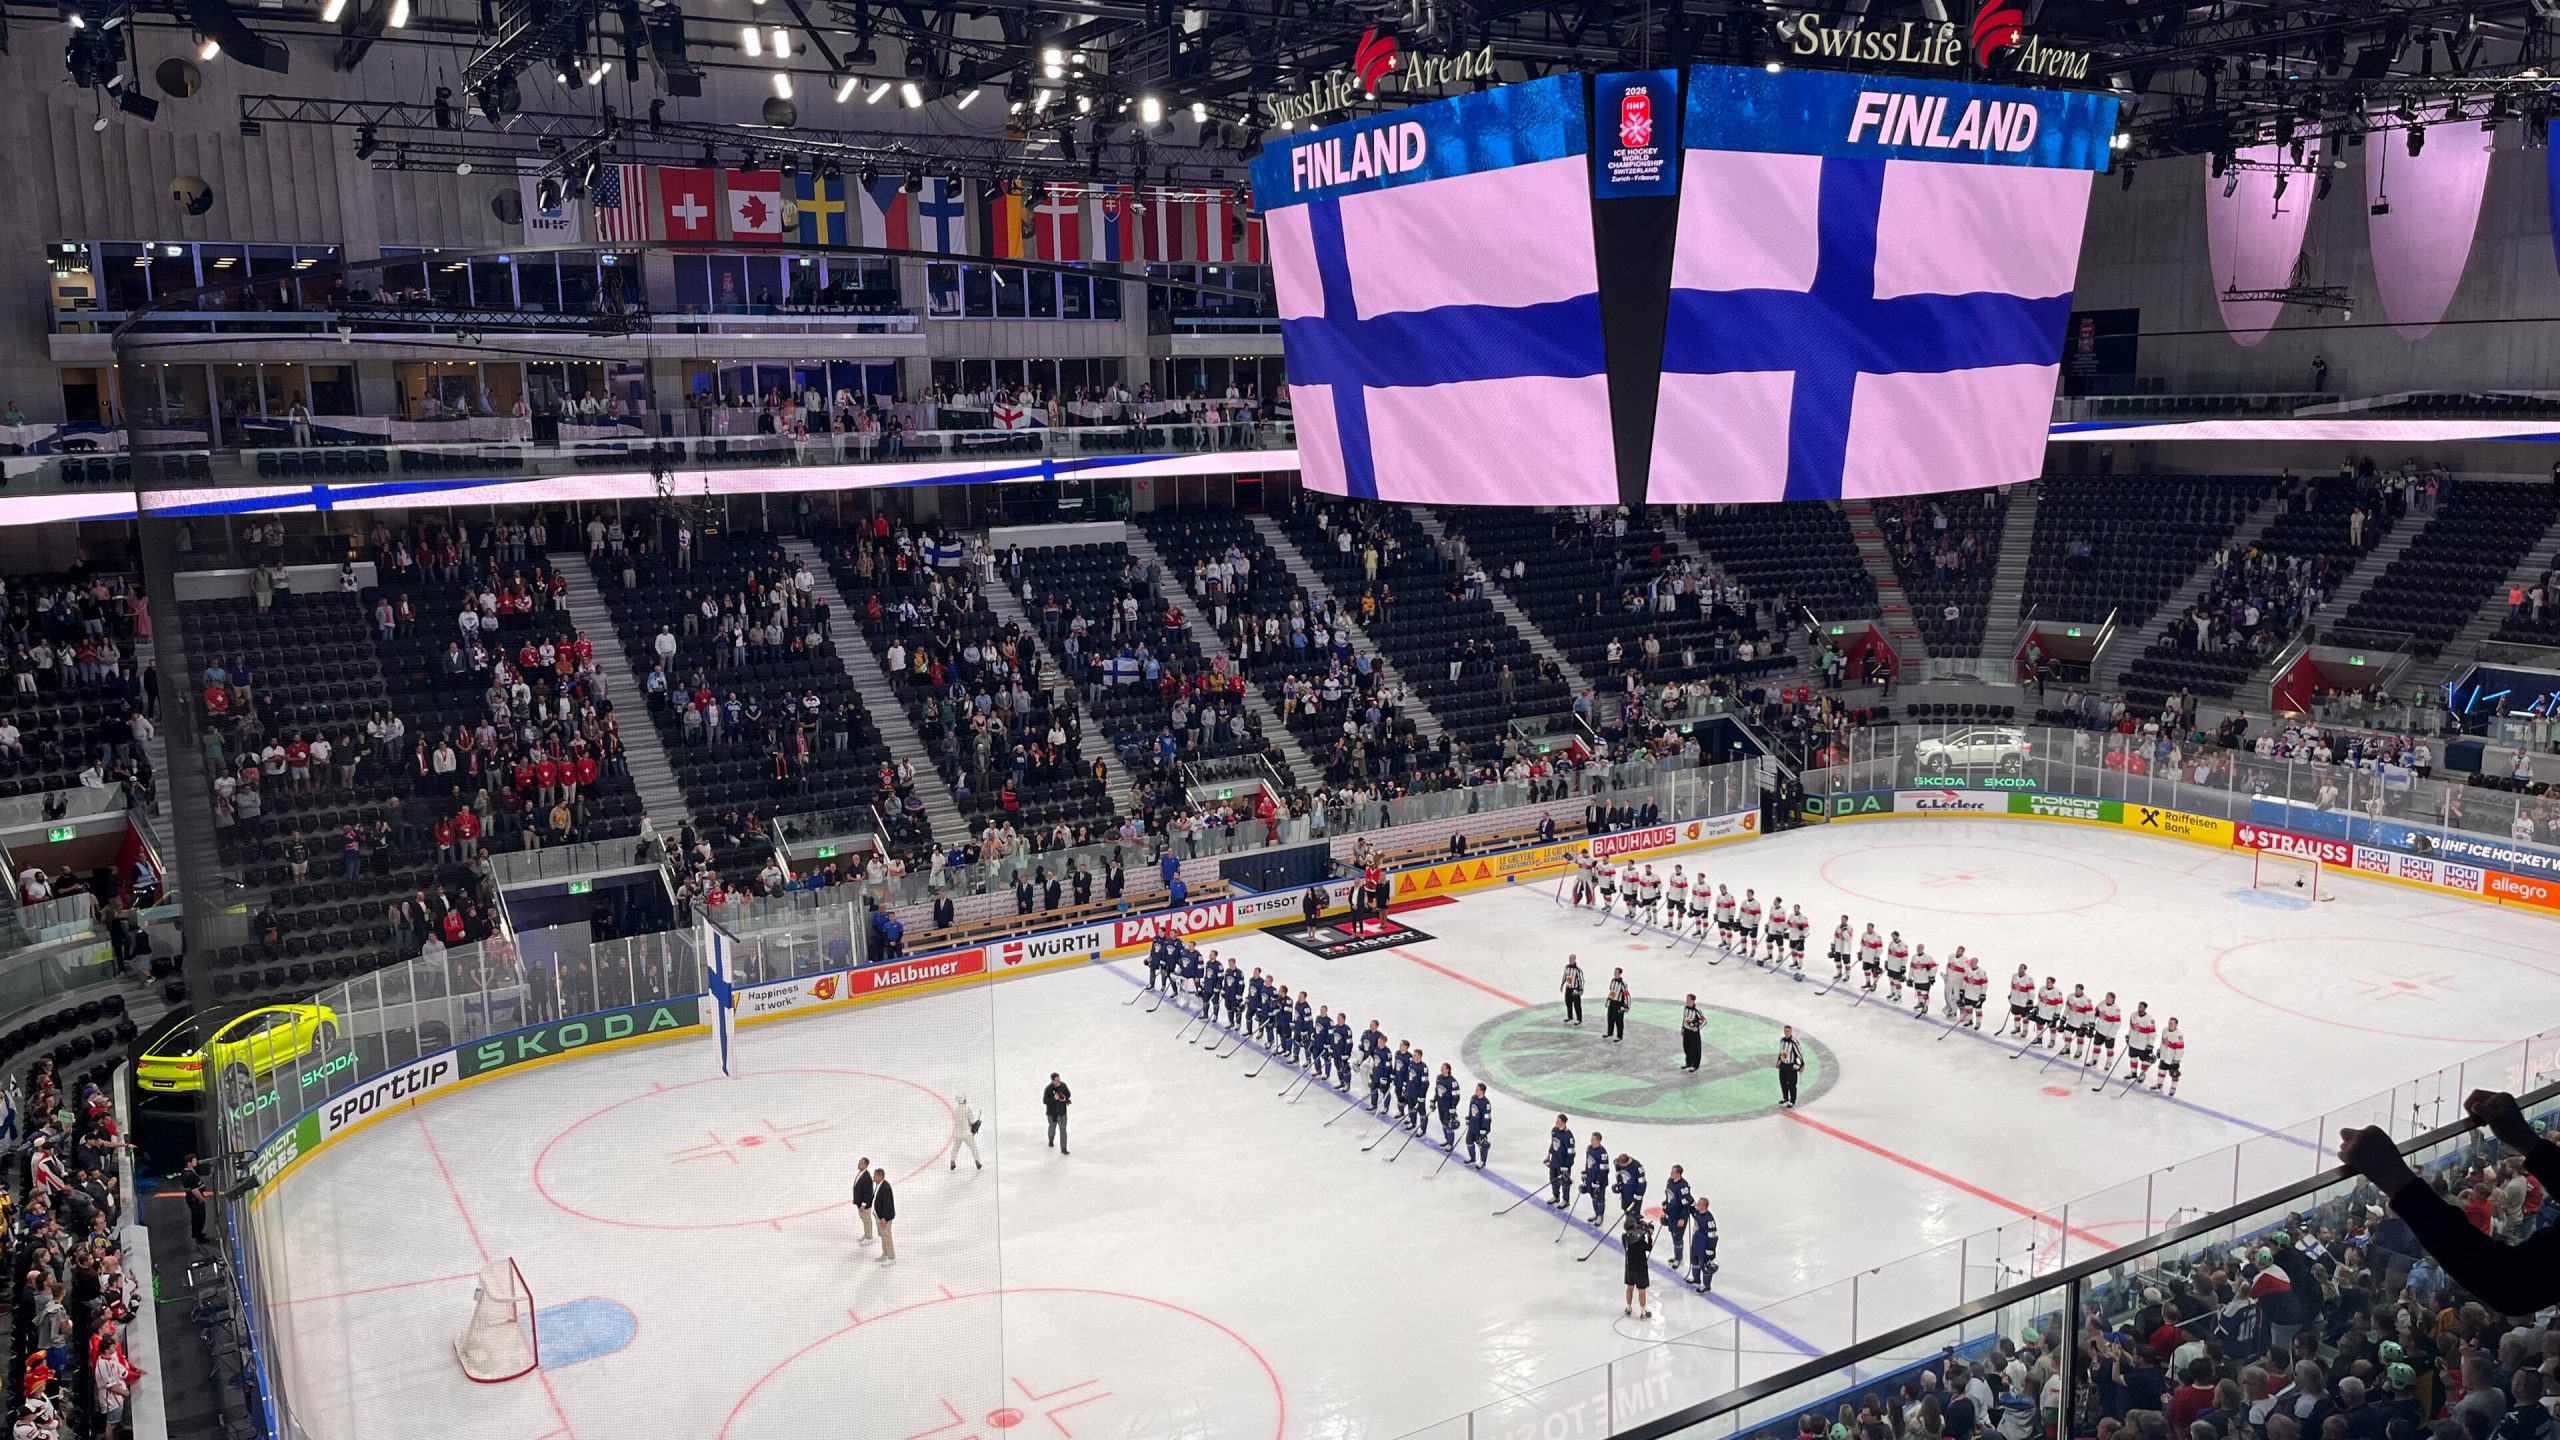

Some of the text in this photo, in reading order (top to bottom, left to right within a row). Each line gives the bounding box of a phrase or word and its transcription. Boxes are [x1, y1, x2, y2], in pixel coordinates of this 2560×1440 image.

[1795, 13, 2091, 80] SwissLife Arena
[1403, 44, 1495, 93] Arena
[1625, 87, 1647, 96] 2026
[1626, 101, 1646, 110] IIHF
[1847, 91, 2039, 153] FINLAND
[1291, 121, 1427, 193] FINLAND
[1614, 147, 1658, 157] ICE HOCKEY
[1622, 154, 1649, 162] WORLD
[1608, 160, 1664, 169] CHAMPIONSHIP
[1613, 167, 1658, 176] SWITZERLAND
[532, 218, 570, 230] IIHF
[2030, 804, 2099, 819] TYRES
[2165, 811, 2218, 830] Raiffeisen
[2164, 822, 2191, 835] Bank
[1594, 827, 1676, 856] BAUHAUS
[2257, 830, 2347, 863] STRAUSS
[2359, 850, 2390, 864] LIQUI
[2405, 832, 2440, 849] 26
[2441, 839, 2468, 853] IIHF
[2468, 844, 2492, 859] ICE
[2492, 846, 2550, 869] HOCKEY
[2358, 859, 2389, 873] MOLY
[2402, 857, 2433, 872] LIQUI
[2401, 867, 2433, 882] MOLY
[2446, 866, 2478, 880] LIQUI
[2445, 876, 2478, 891] MOLY
[2491, 877, 2547, 899] allegro
[1255, 896, 1298, 912] TISSOT
[1121, 903, 1229, 945] PATRON
[1027, 932, 1101, 959] WÜRTH
[1347, 930, 1416, 949] TISSOT
[873, 960, 959, 989] Malbuner
[747, 983, 799, 1001] Happiness
[754, 1003, 765, 1012] at
[256, 1142, 298, 1189] YRES
